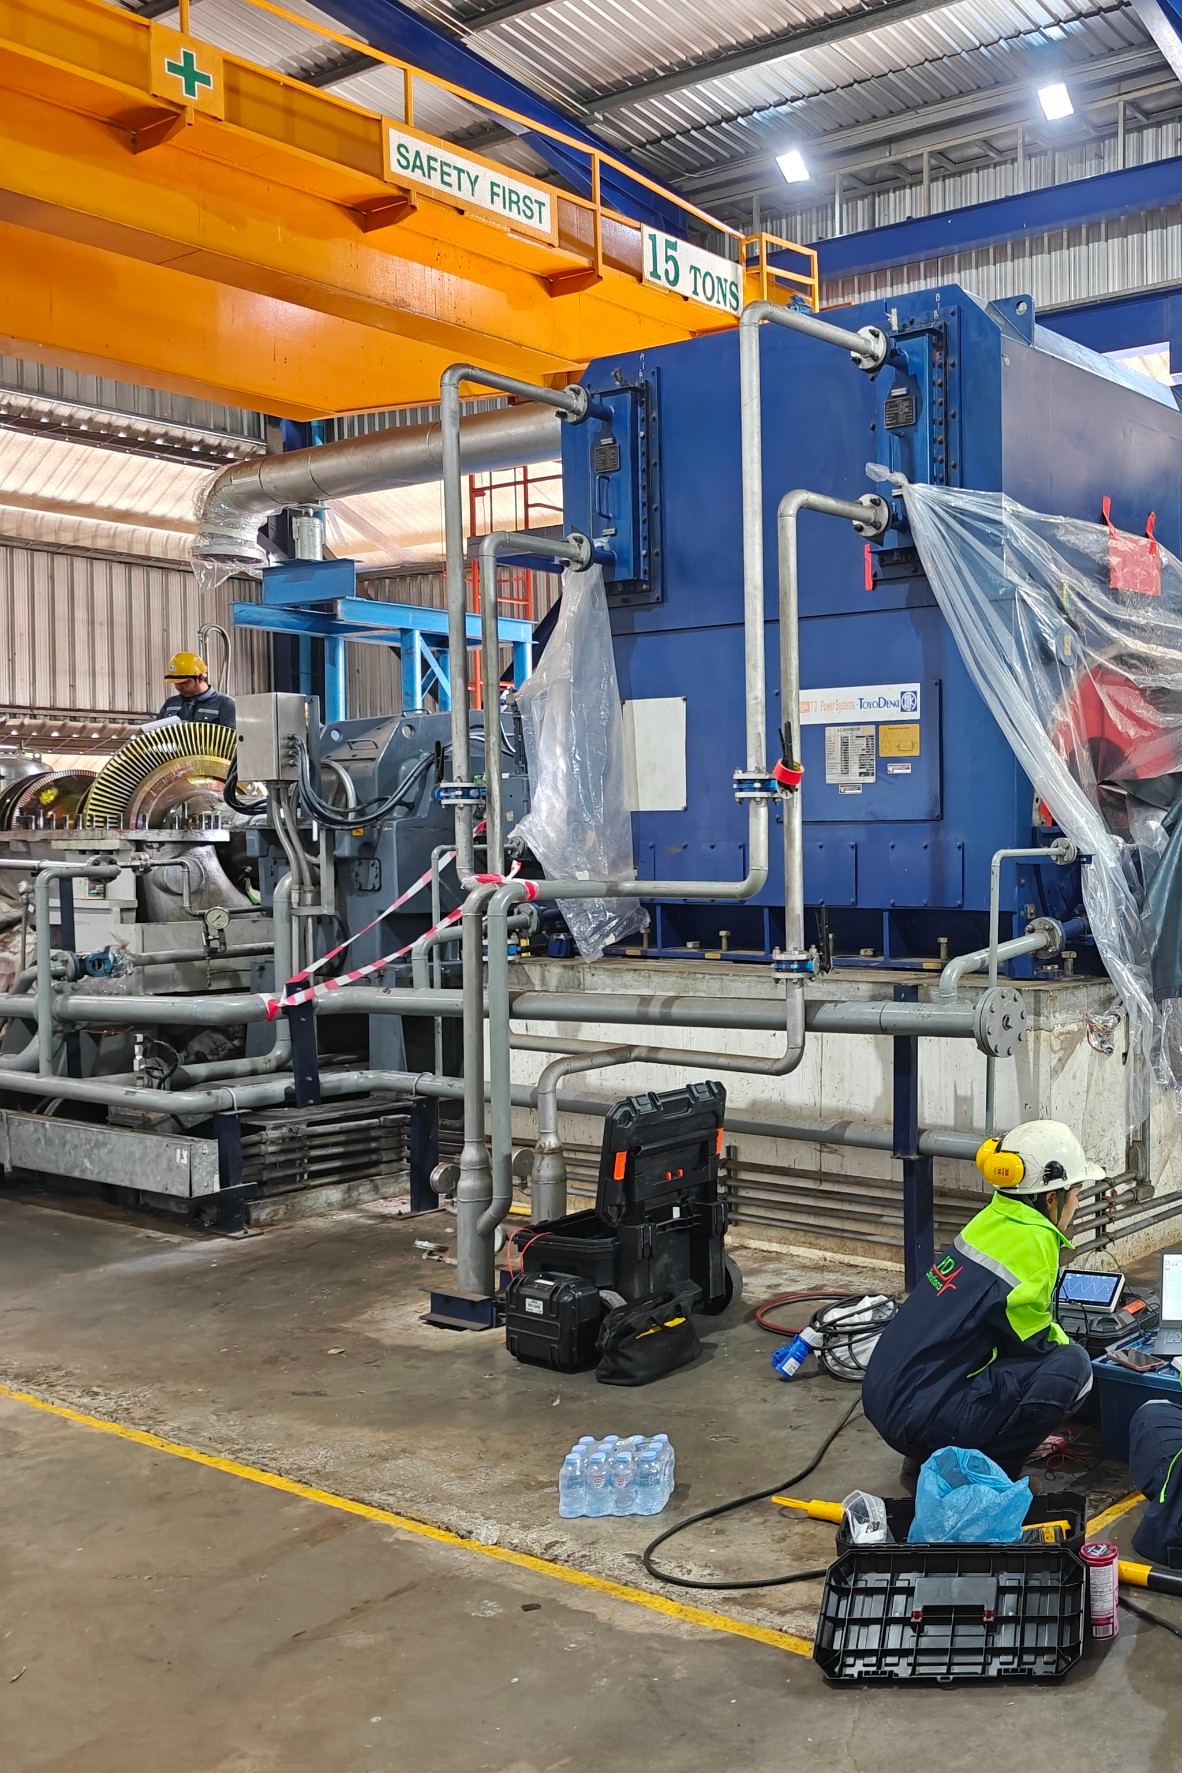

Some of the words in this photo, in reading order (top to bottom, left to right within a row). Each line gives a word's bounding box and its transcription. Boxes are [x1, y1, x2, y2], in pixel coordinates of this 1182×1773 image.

[396, 143, 479, 197] SAFETY
[489, 180, 546, 225] FIRST
[648, 233, 680, 288] 15
[689, 264, 740, 312] TONS
